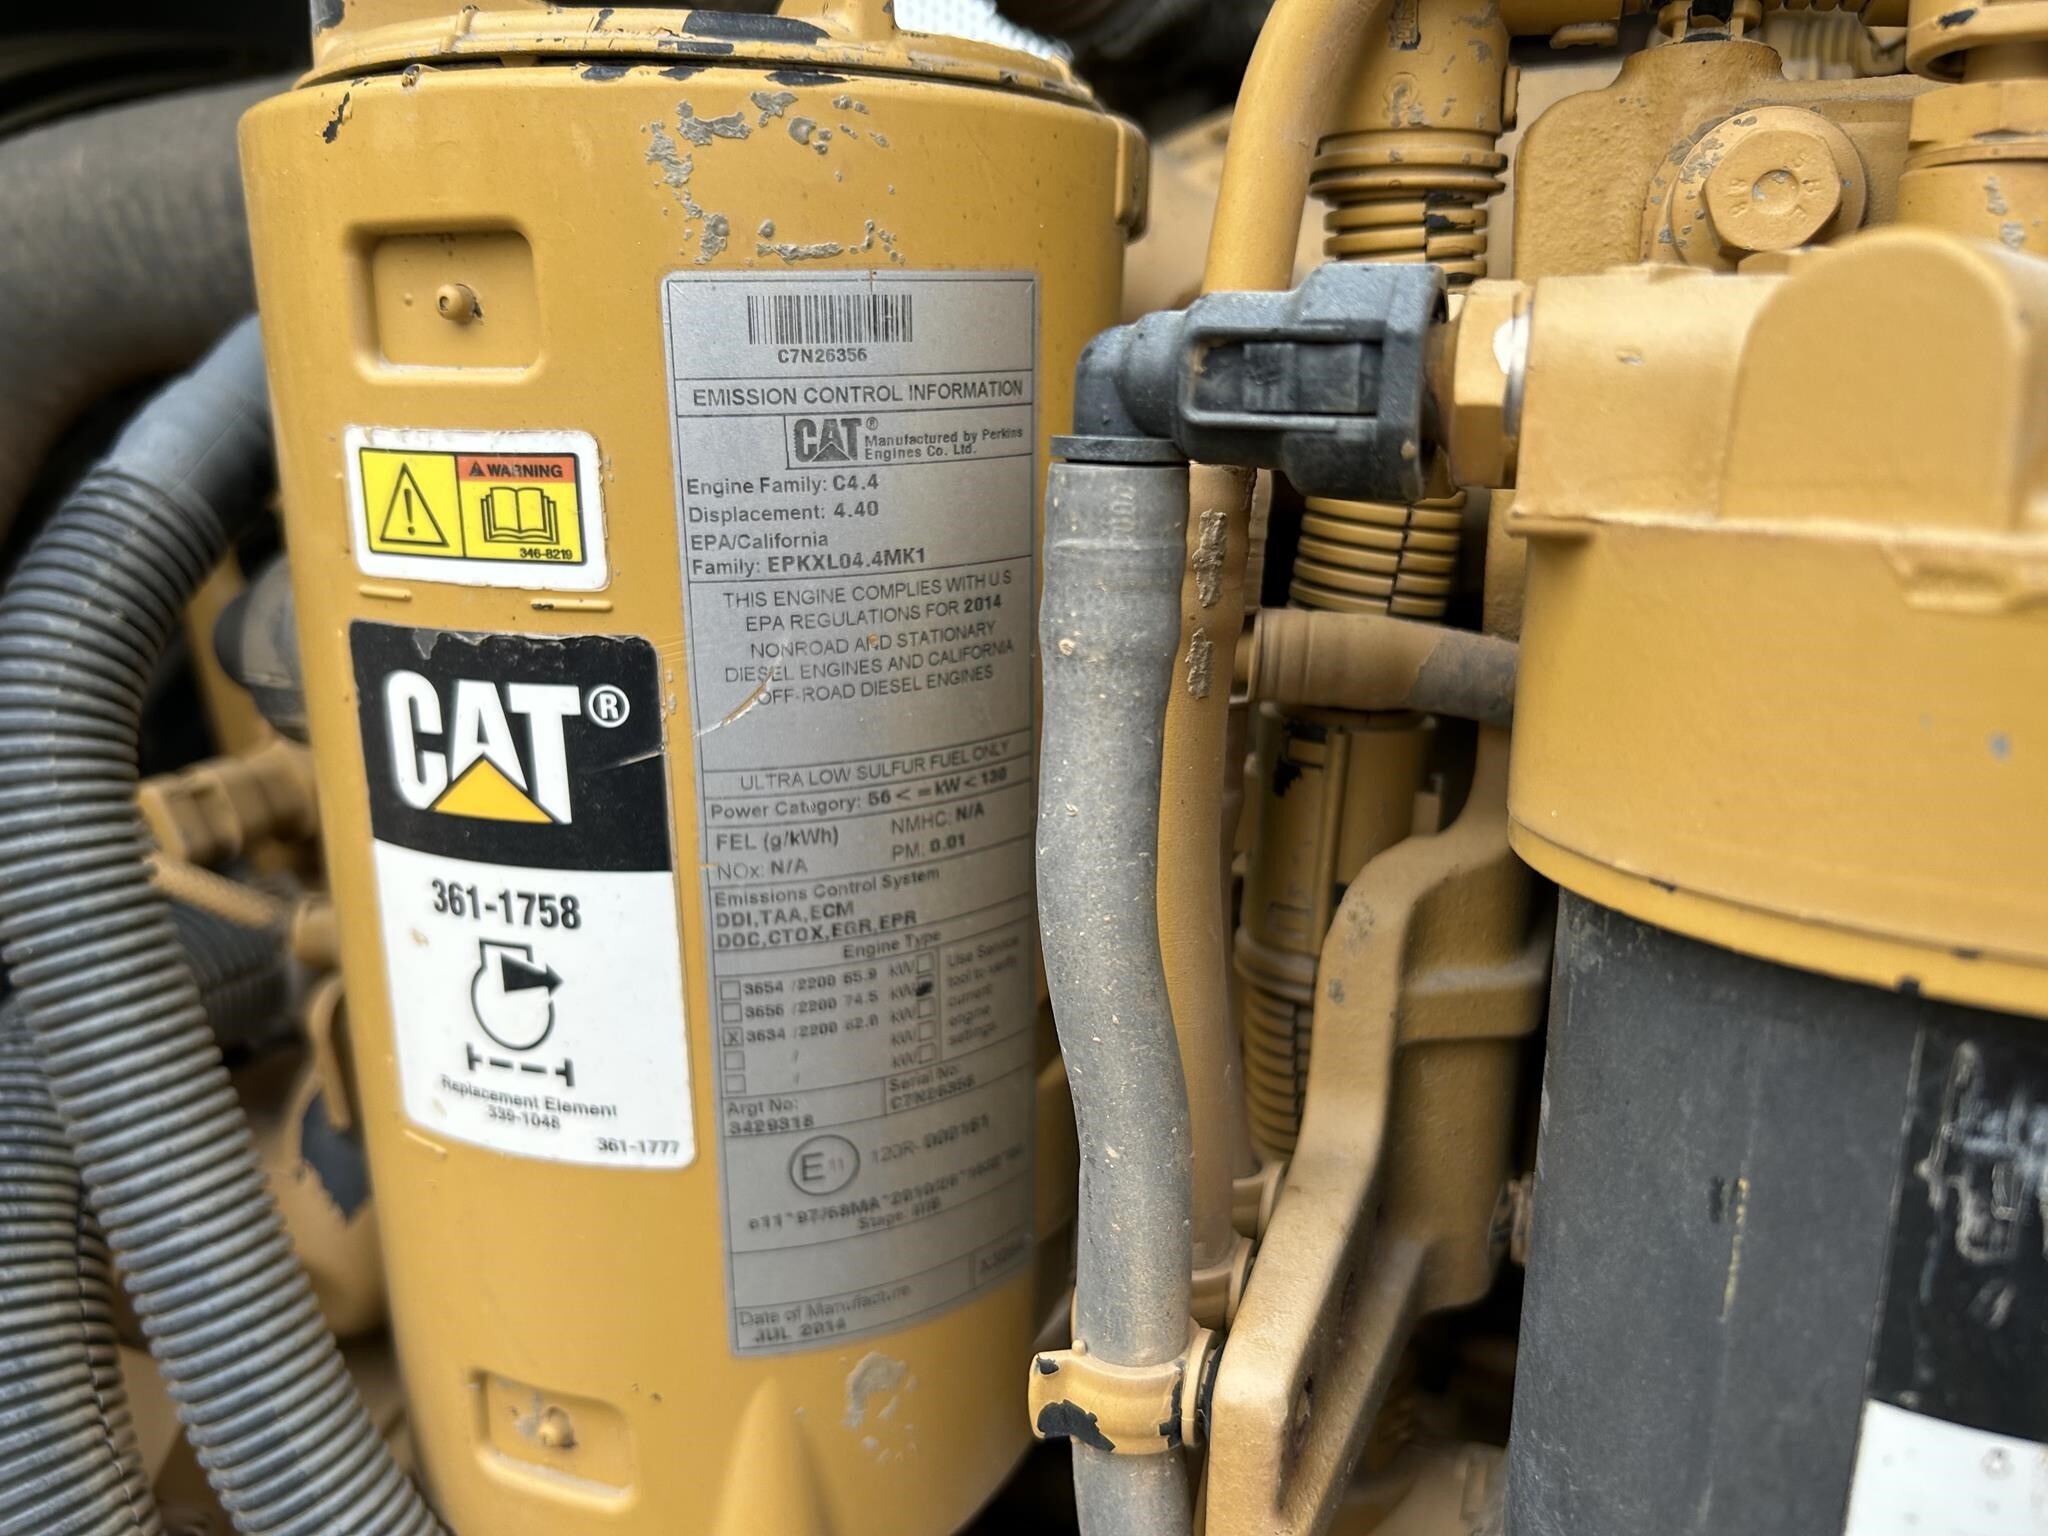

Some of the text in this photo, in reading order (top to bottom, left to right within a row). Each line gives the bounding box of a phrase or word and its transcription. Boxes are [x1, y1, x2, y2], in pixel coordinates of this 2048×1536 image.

[778, 348, 867, 364] C7N26356
[692, 380, 1023, 407] EMISSION CONTROL INFORMATION
[864, 427, 1024, 448] Manufactured by Perkins
[865, 443, 977, 461] Engines Co. Ltd.
[486, 463, 563, 478] WARNING
[687, 474, 879, 498] Engine Family: C4.4
[689, 501, 879, 527] Displacement: 4.40
[519, 548, 573, 560] 346-8219
[691, 533, 829, 551] EPA/California
[693, 548, 926, 577] Family: EPKXL04.4MK1
[723, 591, 768, 609] THIS
[774, 588, 846, 607] ENGINE
[852, 579, 942, 602] COMPLIES
[946, 573, 986, 593] WITH
[746, 595, 1003, 632] EPA REGULATIONS FOR 2014
[750, 621, 997, 659] NONROAD AND STATIONARY
[725, 639, 1014, 684] DIESEL ENGINES AND CALIFORNIA
[757, 664, 994, 706] OFF-ROAD DIESEL ENGINES
[740, 741, 1011, 792] ULTRA LOW SULFUR FUEL ONLY
[711, 802, 769, 820] Power
[775, 795, 862, 818] Category:
[868, 790, 892, 807] 56
[936, 778, 962, 797] kW
[955, 801, 986, 824] N/A
[716, 826, 840, 852] FEL (g/kWh)
[929, 832, 967, 853] 0.01
[770, 858, 809, 875] N/A
[714, 867, 941, 910] Emissions Control System
[431, 877, 582, 930] 361-1758
[843, 930, 942, 962] Engine Type
[441, 1073, 618, 1118] Replacement Element
[597, 1136, 680, 1156] 361-1777
[857, 1209, 904, 1231] Stage
[738, 1283, 913, 1327] Date of Manufacture
